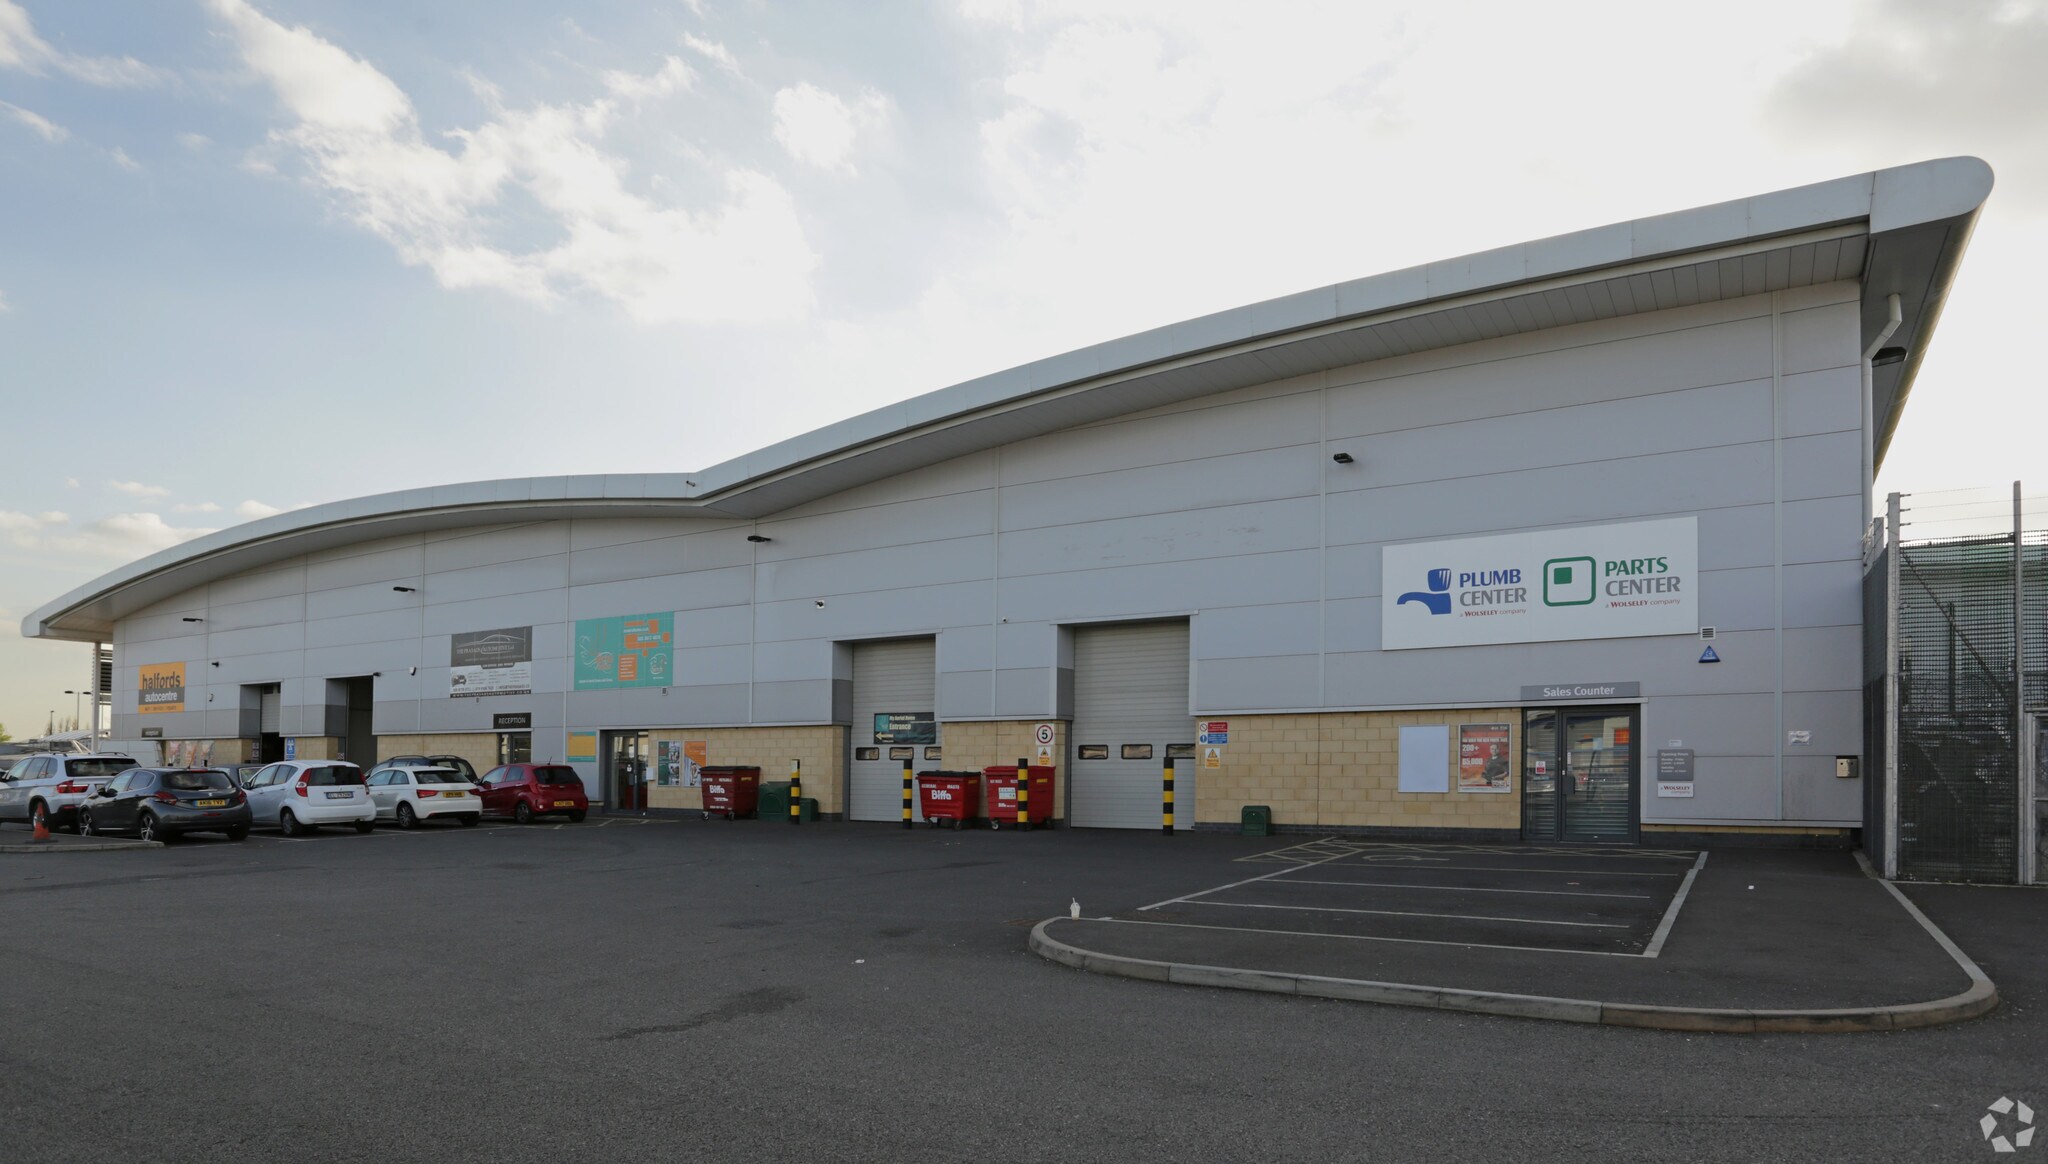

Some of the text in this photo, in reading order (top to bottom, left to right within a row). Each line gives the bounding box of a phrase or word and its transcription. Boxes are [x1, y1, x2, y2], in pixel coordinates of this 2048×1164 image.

[1605, 556, 1668, 577] PARTS
[1459, 568, 1522, 588] PLUMB
[1605, 576, 1681, 596] CENTER
[1459, 587, 1527, 606] CENTER
[1610, 600, 1649, 608] WOLSELEY
[1464, 609, 1498, 617] WOLSELEY
[142, 672, 181, 690] halfords
[145, 691, 178, 702] autocentre
[1543, 686, 1616, 697] Sales Counter
[498, 717, 527, 725] RECEPTION
[889, 723, 912, 731] Entrance
[1041, 729, 1048, 740] 5
[709, 784, 725, 794] Biffa
[931, 789, 952, 800] Biffa
